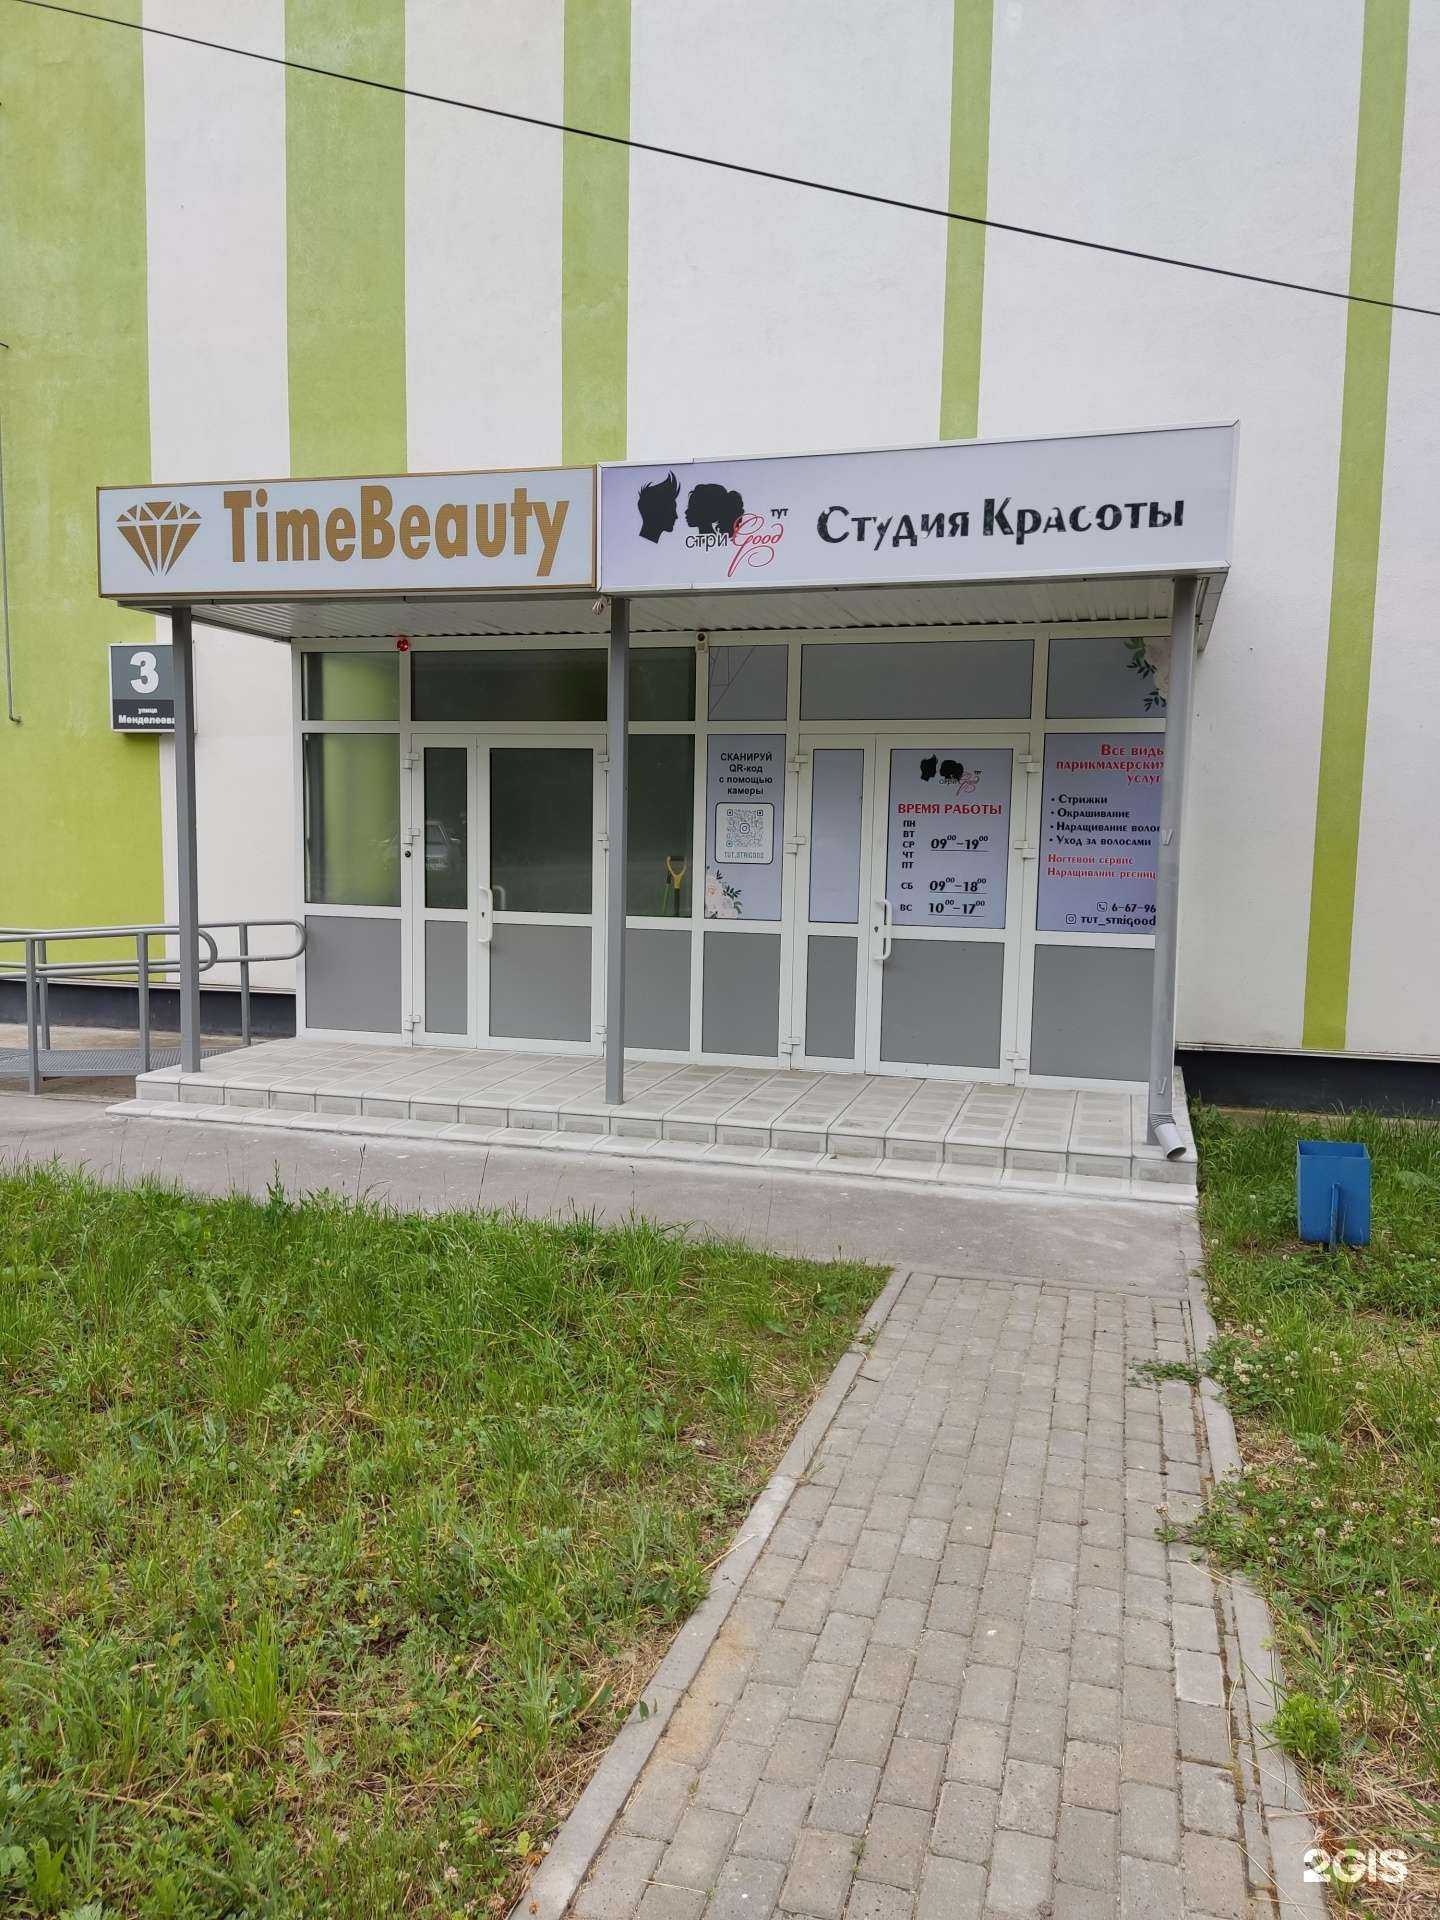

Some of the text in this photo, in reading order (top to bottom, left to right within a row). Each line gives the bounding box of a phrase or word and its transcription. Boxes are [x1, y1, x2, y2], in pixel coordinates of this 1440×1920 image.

[770, 508, 789, 519] тут
[816, 497, 1185, 551] Студия Красоты
[223, 485, 571, 577] TimeBeauty
[129, 651, 160, 694] 3
[137, 707, 158, 715] улица
[1100, 743, 1126, 756] Все
[720, 752, 773, 761] СКАНИРУЙ
[728, 764, 763, 774] QR-код
[726, 776, 773, 785] помощью
[727, 787, 764, 797] камеры
[1058, 794, 1108, 806] Стрижки
[897, 803, 1003, 815] ВРЕМЯ РАБОТЫ
[1057, 808, 1131, 819] Окрашивание
[903, 820, 916, 828] ПН
[1056, 821, 1128, 833] Наращивание
[903, 830, 915, 838] ВТ
[902, 841, 915, 849] СР
[1056, 835, 1083, 846] Уход
[1100, 838, 1152, 846] волосами
[902, 851, 914, 859] ЧТ
[901, 861, 914, 869] ПТ
[1099, 857, 1134, 866] сервис
[1047, 867, 1115, 878] Наращивание
[900, 882, 914, 890] СБ
[900, 904, 913, 912] ВС
